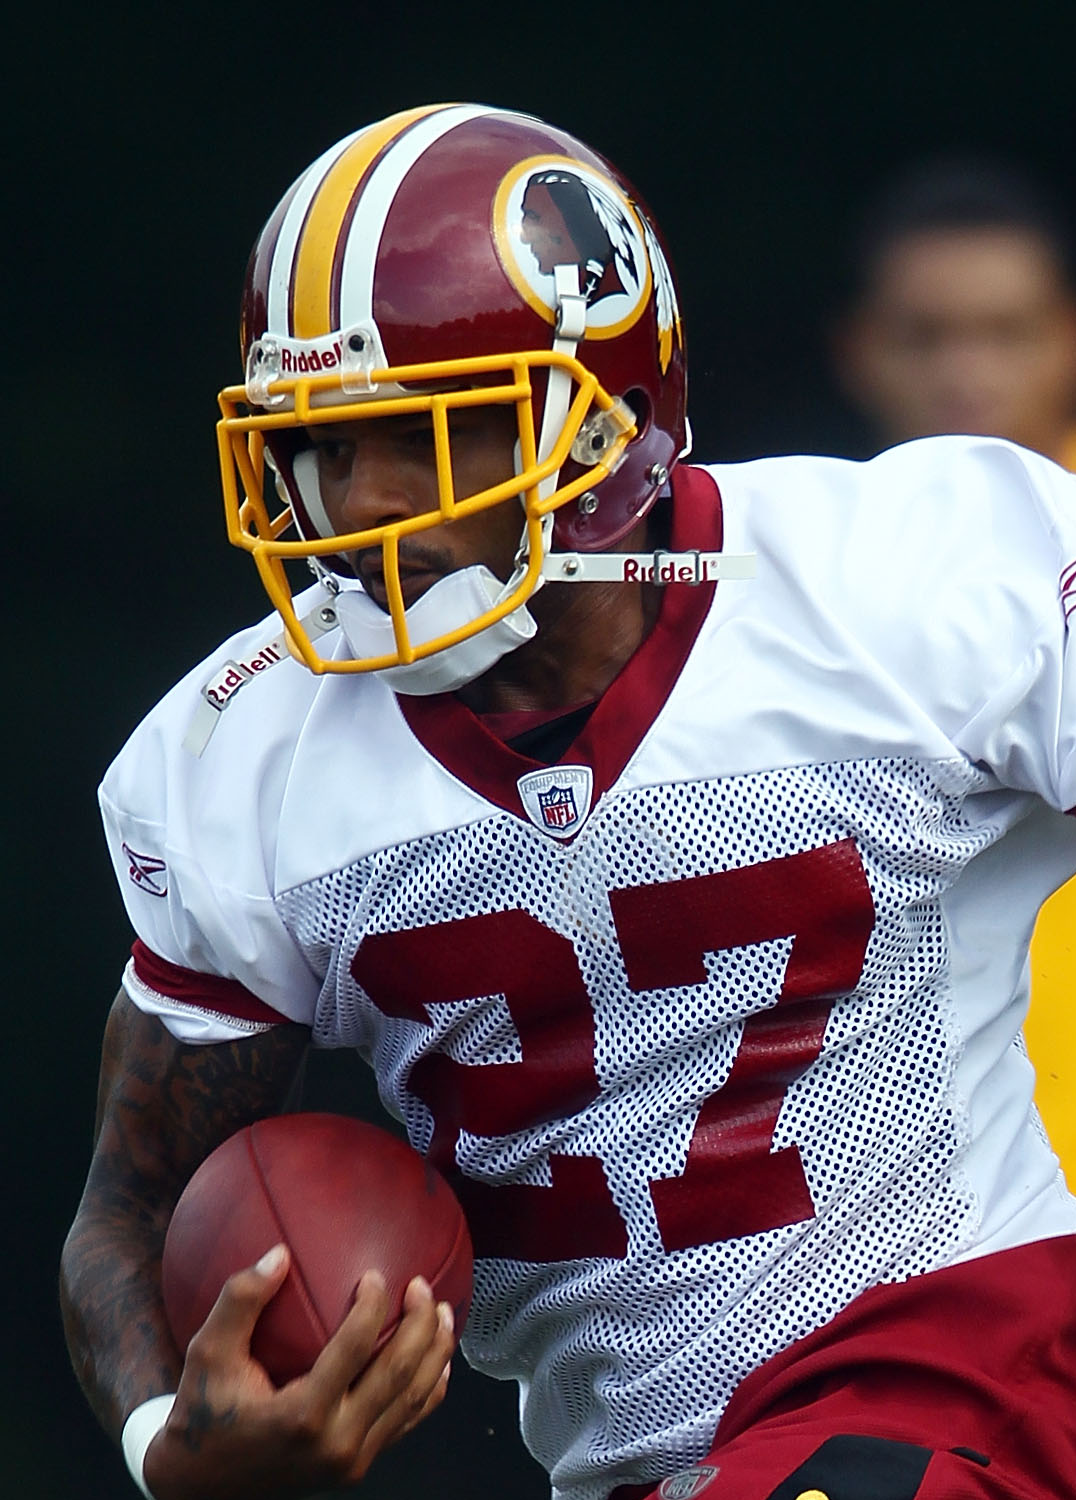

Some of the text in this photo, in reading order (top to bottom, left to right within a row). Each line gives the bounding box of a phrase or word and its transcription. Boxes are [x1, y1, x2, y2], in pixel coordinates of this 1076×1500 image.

[282, 340, 343, 372] Riddel
[623, 558, 708, 582] Ridel
[523, 772, 586, 794] EQUIPMENT
[544, 803, 575, 827] NFL
[350, 838, 876, 1261] 27
